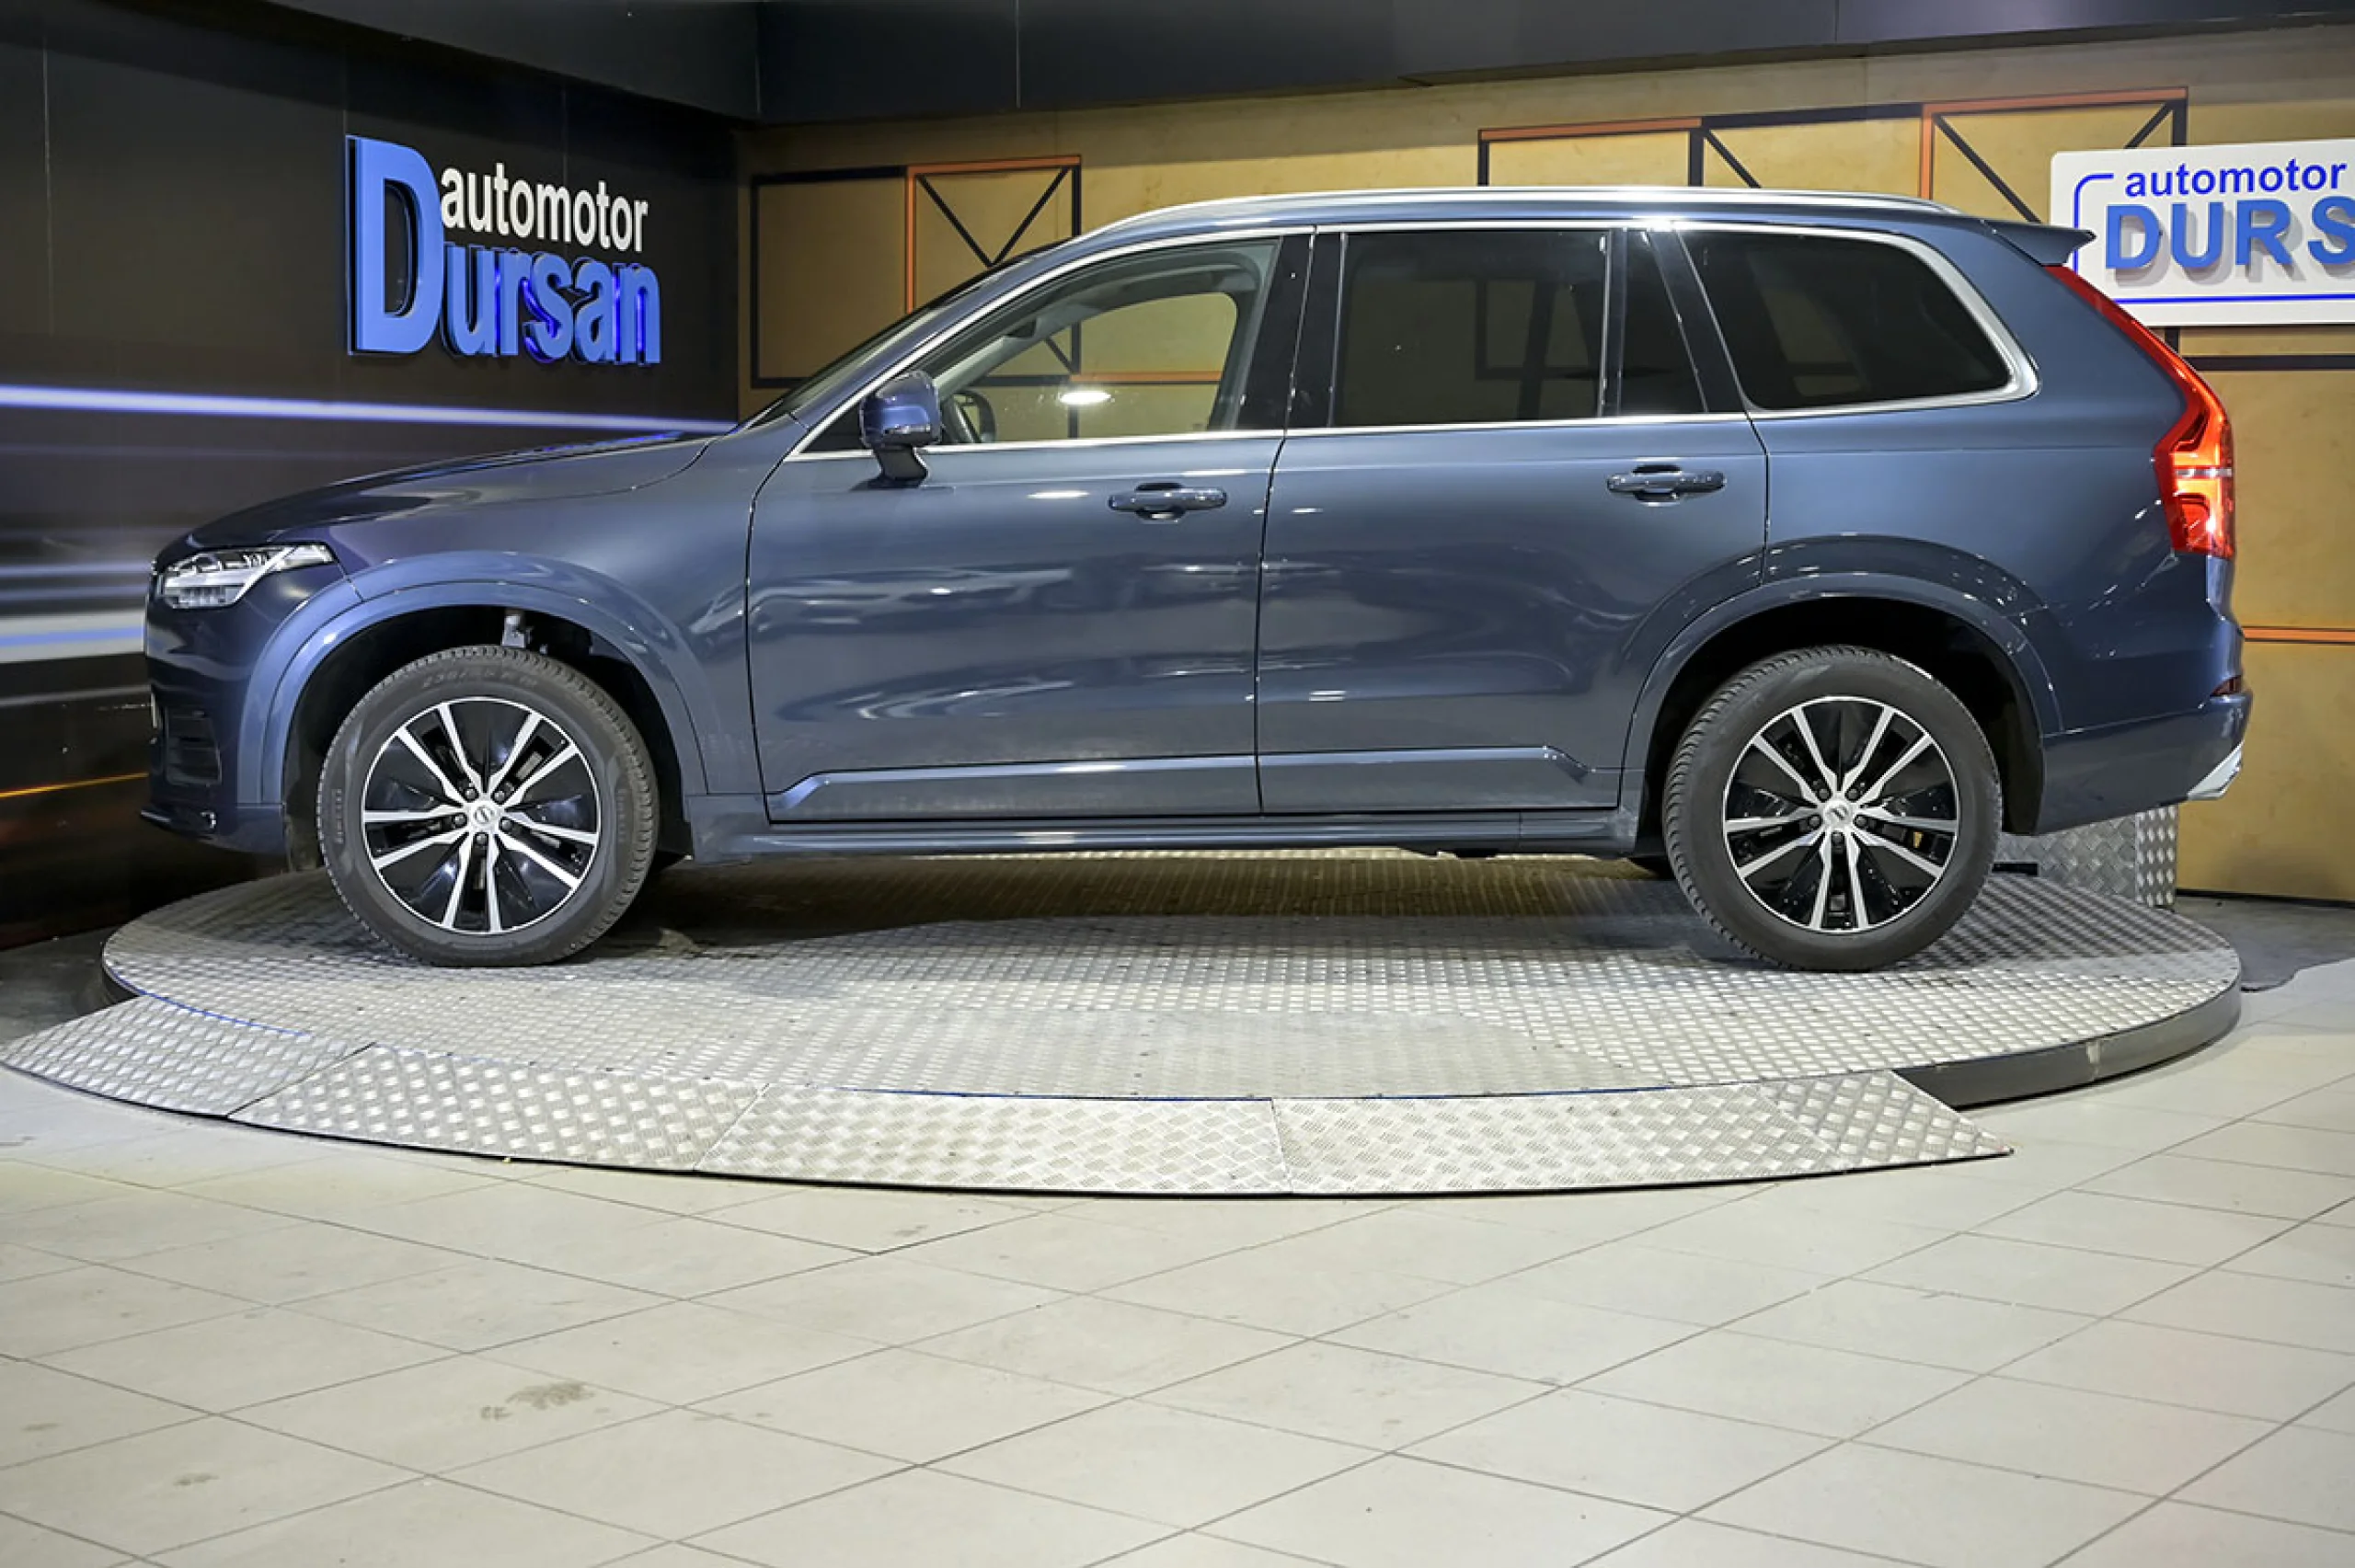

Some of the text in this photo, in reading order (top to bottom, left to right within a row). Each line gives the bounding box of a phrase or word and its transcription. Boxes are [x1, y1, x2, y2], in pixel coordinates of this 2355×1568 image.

[441, 162, 649, 252] automotor
[2125, 158, 2348, 197] automotor
[345, 134, 661, 365] Dursan
